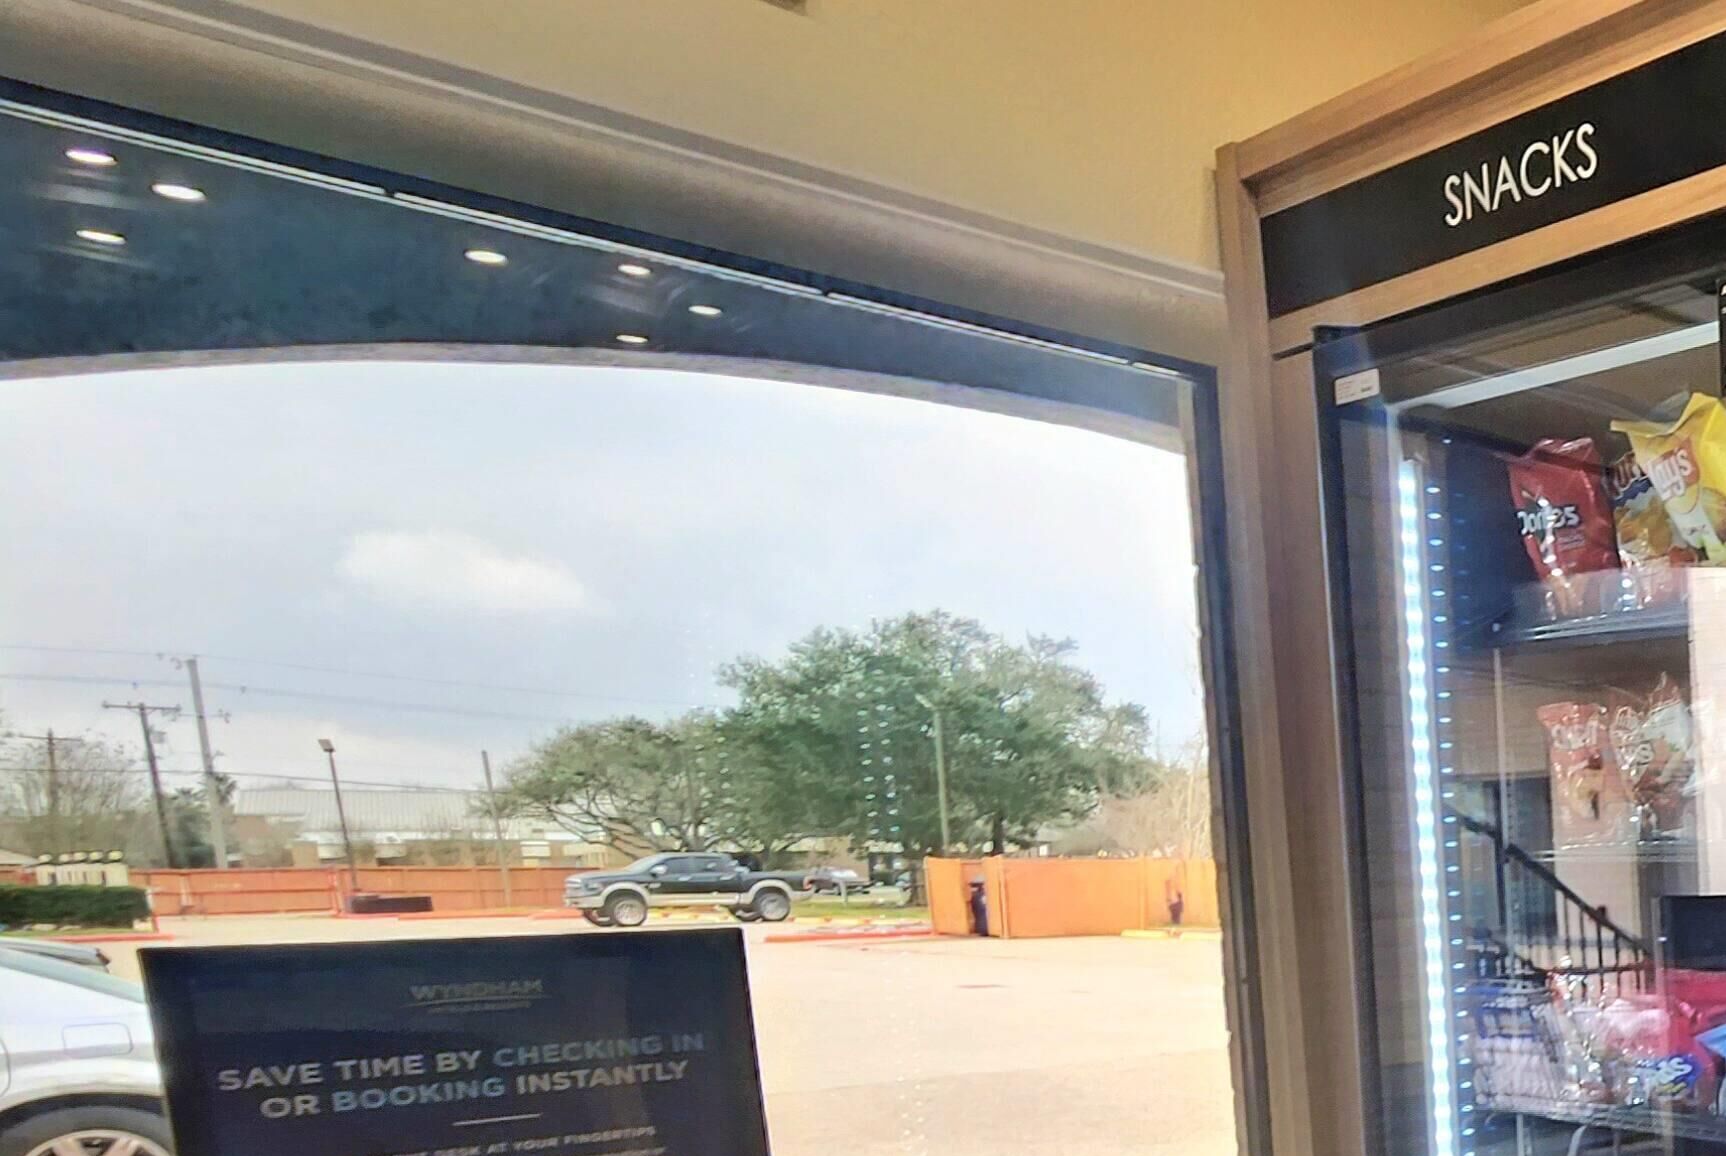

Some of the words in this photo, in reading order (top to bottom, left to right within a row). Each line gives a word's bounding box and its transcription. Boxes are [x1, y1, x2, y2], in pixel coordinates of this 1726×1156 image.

[1444, 123, 1598, 226] SNACKS
[410, 979, 544, 1000] WYNDHAM
[218, 1061, 324, 1092] SAVE
[333, 1053, 426, 1082] TIME
[435, 1049, 483, 1074] BY
[491, 1035, 664, 1069] CHECKING
[673, 1032, 706, 1052] IN
[259, 1092, 321, 1119] OR
[331, 1076, 506, 1113] BOOKING
[515, 1059, 689, 1096] INSTANTLY
[487, 1141, 509, 1155] AT
[512, 1136, 560, 1152] YOUR
[563, 1125, 656, 1145] FINGERTIPS
